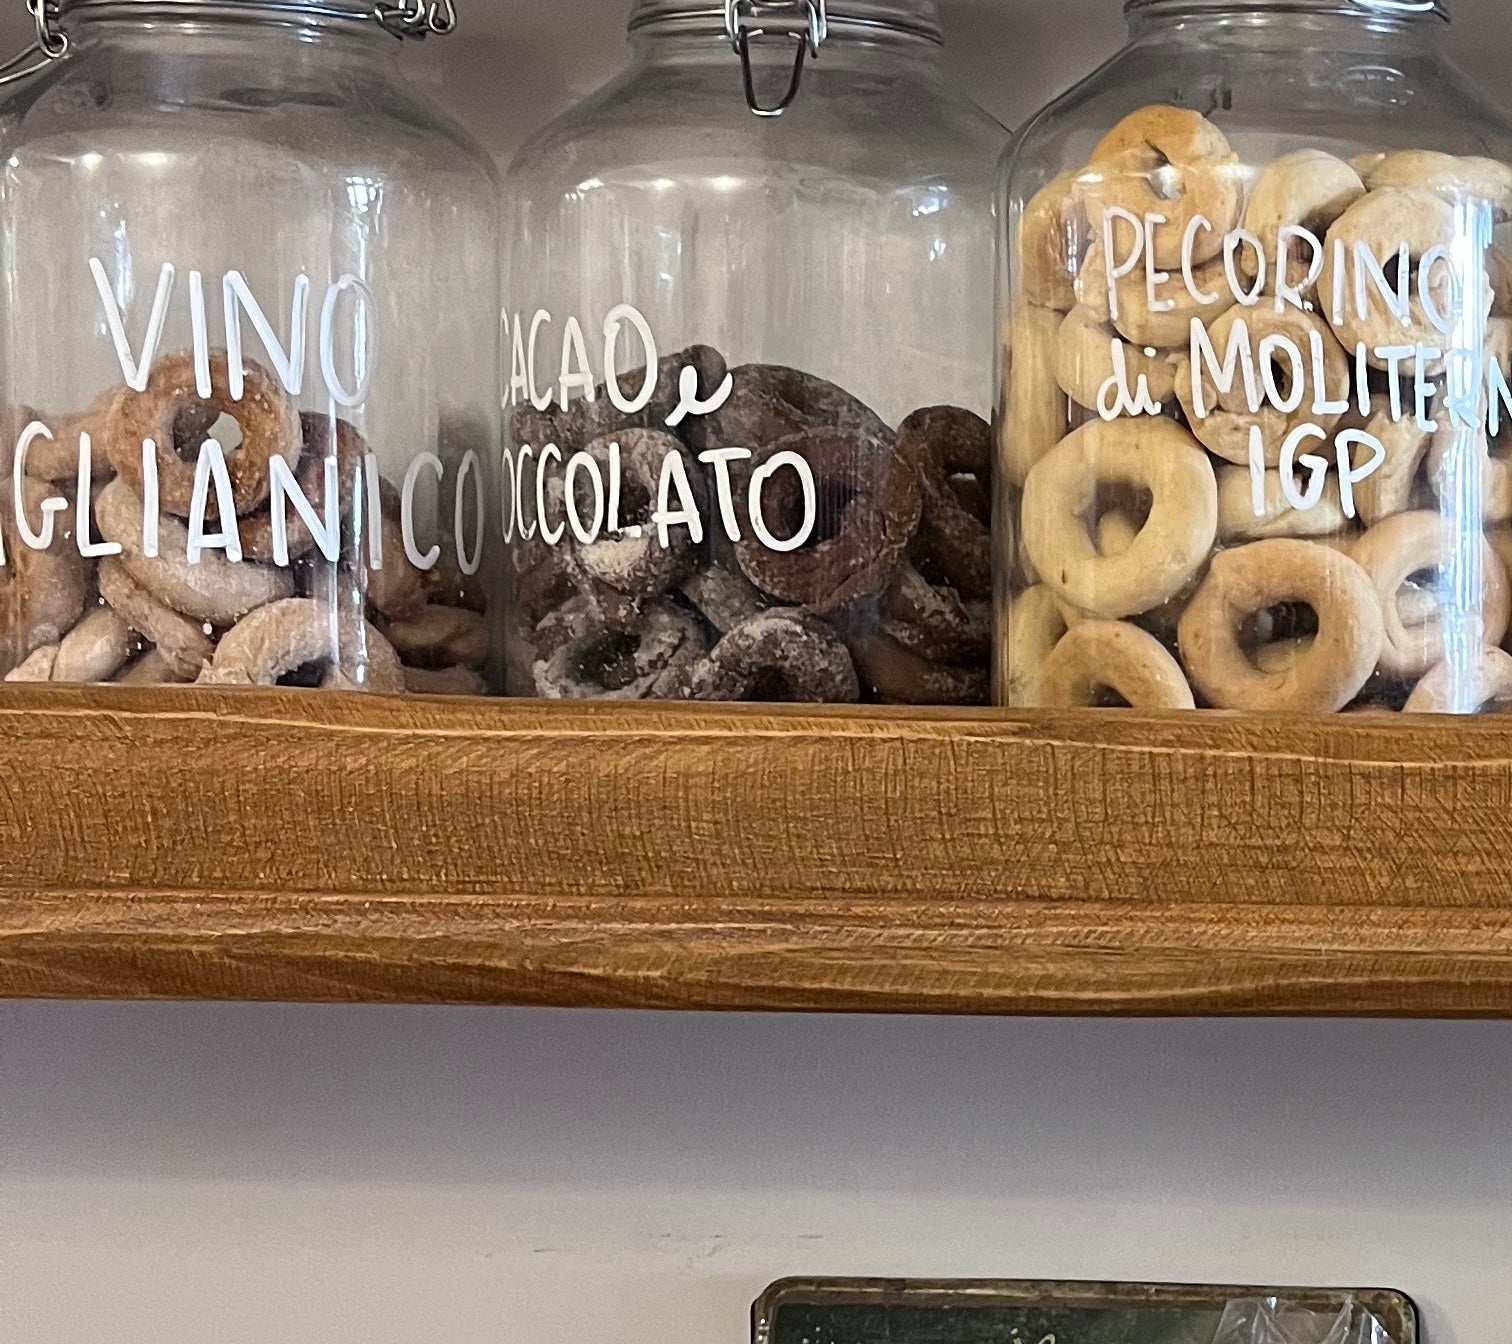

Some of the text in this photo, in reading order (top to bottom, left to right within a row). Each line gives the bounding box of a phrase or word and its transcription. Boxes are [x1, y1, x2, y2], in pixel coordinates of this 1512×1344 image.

[88, 256, 379, 408] VINO
[1102, 206, 1460, 335] PECORINO
[1097, 337, 1162, 422] di
[2, 420, 485, 577] GLIANICO
[1248, 424, 1386, 519] IGP
